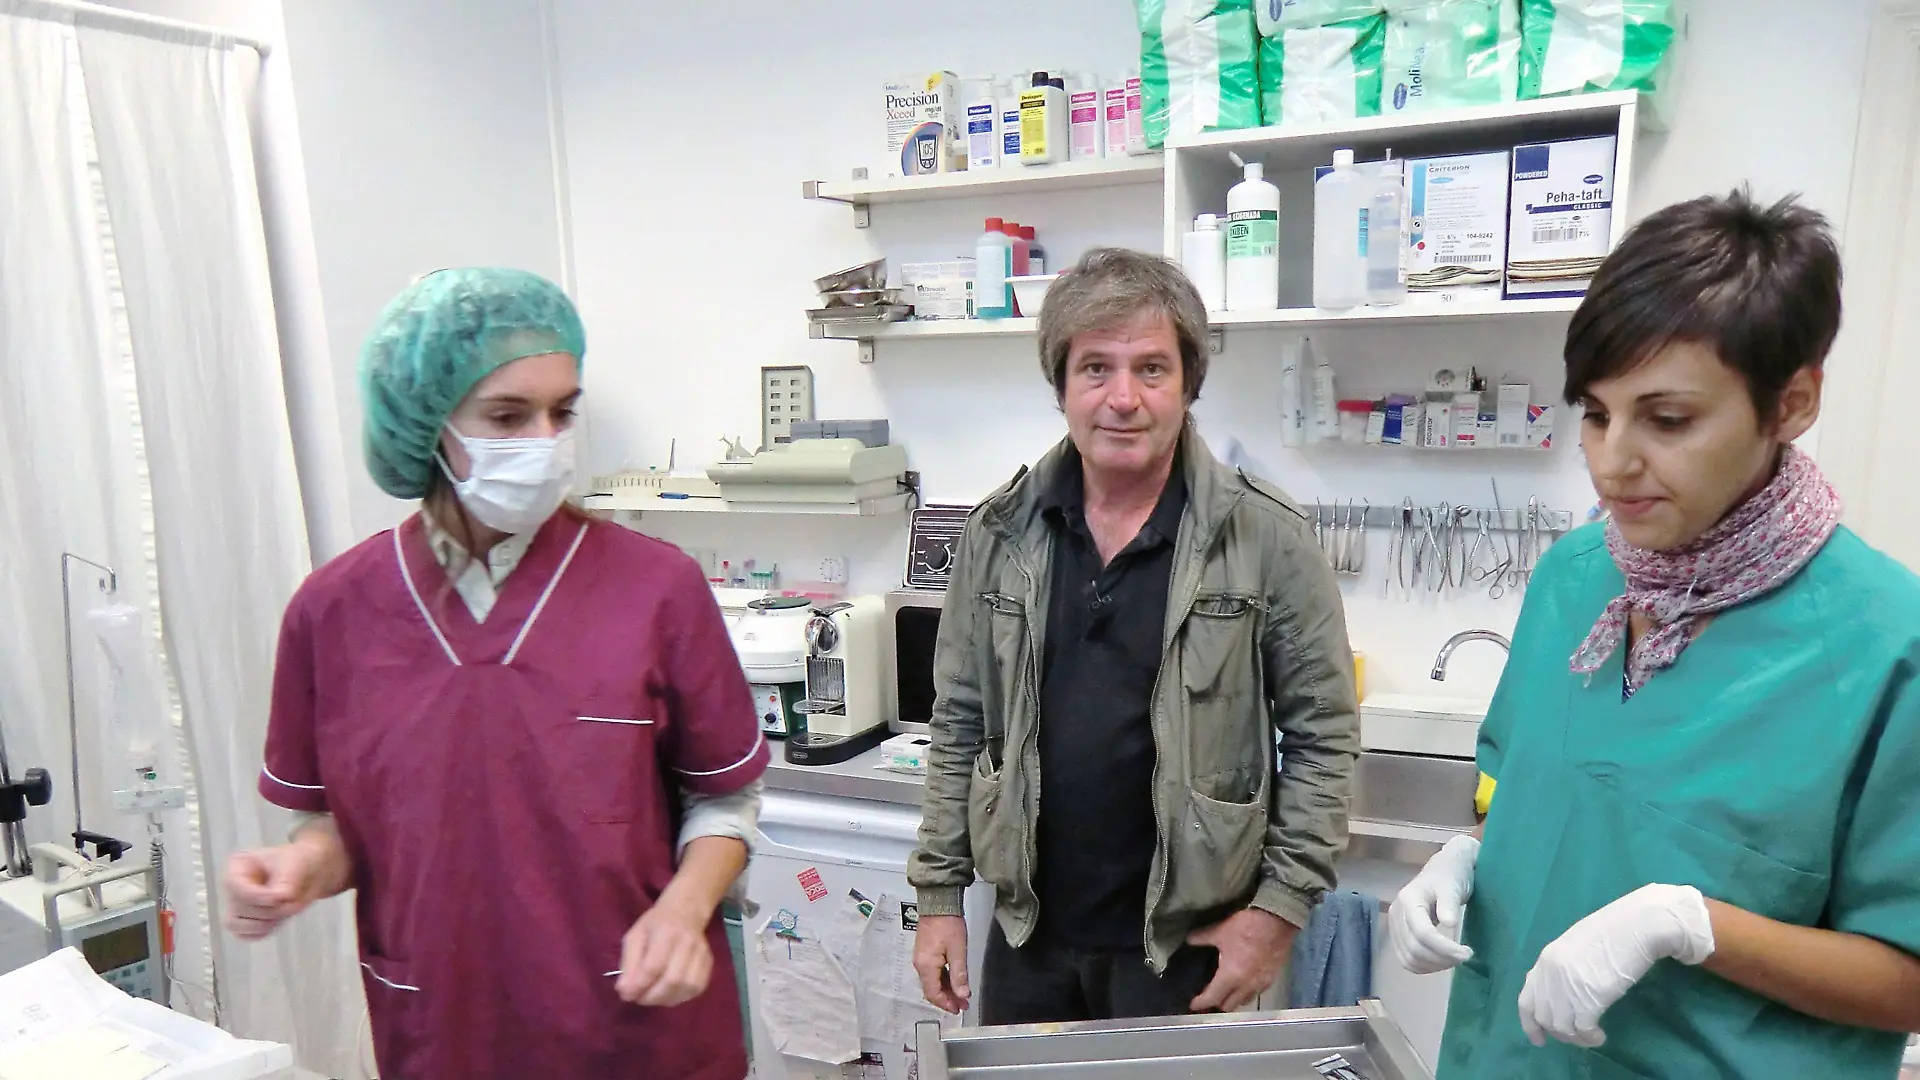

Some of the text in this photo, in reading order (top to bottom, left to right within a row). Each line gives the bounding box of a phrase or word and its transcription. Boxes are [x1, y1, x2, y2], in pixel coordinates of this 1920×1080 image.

[886, 91, 939, 108] Precision
[887, 108, 915, 119] Xceed
[1429, 165, 1470, 173] CRITERION
[1515, 170, 1548, 179] POWDERED
[1546, 188, 1602, 203] Peha-taft
[1573, 202, 1602, 210] CLASSIC
